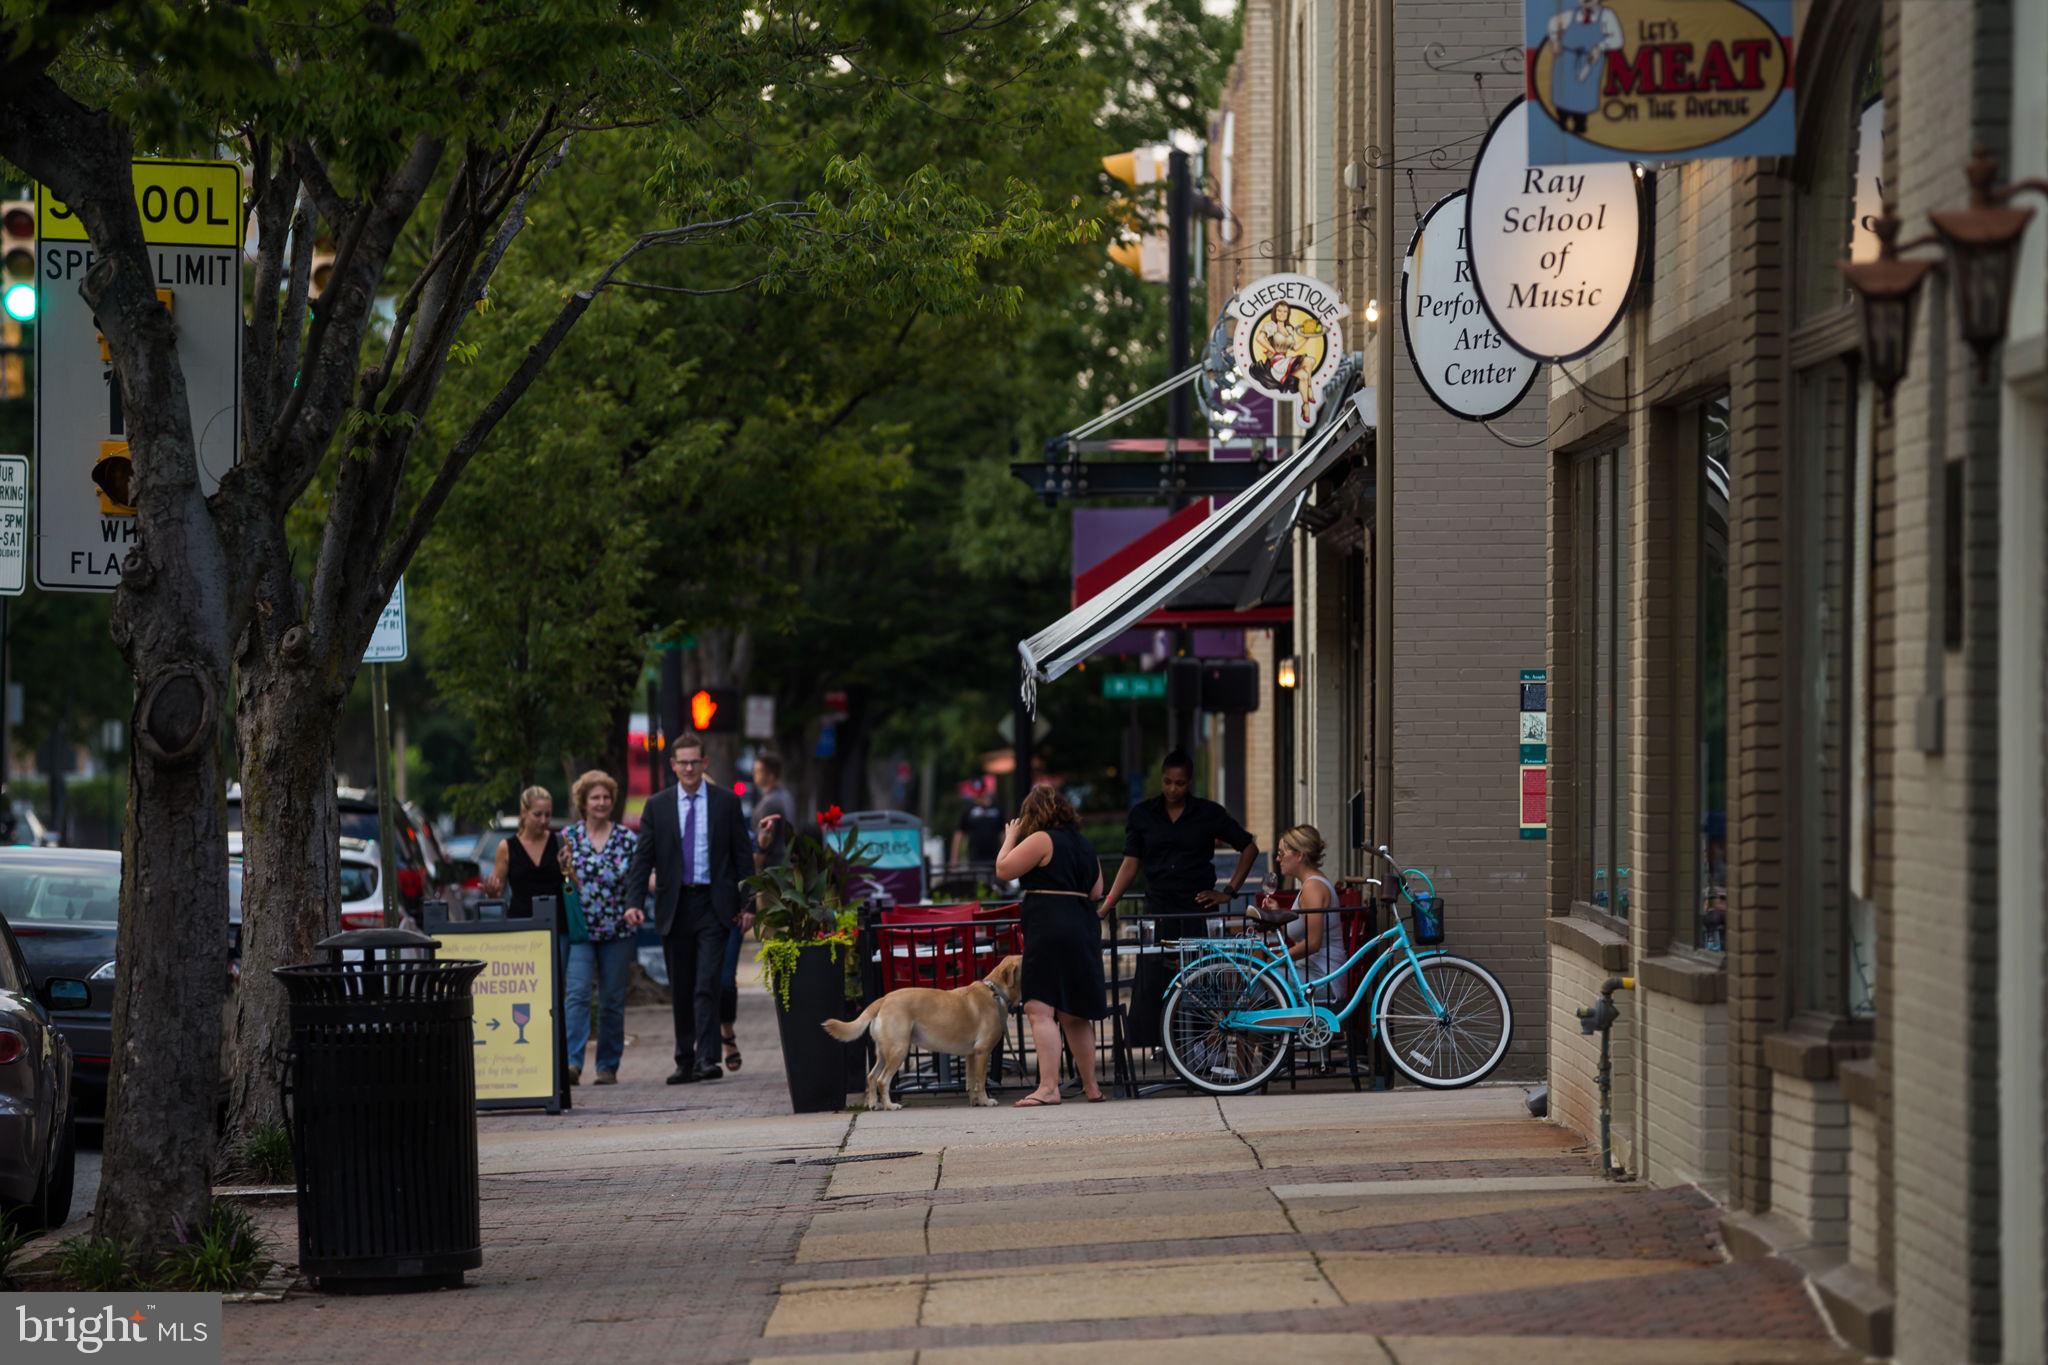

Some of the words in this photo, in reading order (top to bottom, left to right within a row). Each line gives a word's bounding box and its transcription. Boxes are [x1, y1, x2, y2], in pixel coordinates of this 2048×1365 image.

[1603, 39, 1772, 96] MEAT
[1522, 168, 1585, 202] Ray
[50, 185, 229, 225] SOOL
[1502, 204, 1608, 233] School
[158, 253, 231, 286] LIMIT
[1540, 241, 1573, 279] of
[1239, 282, 1338, 320] CHEESETIQUE
[1506, 281, 1603, 309] Music
[1454, 328, 1502, 351] Arts
[1444, 363, 1517, 386] Center
[0, 485, 23, 501] RKING
[491, 960, 535, 977] DOWN
